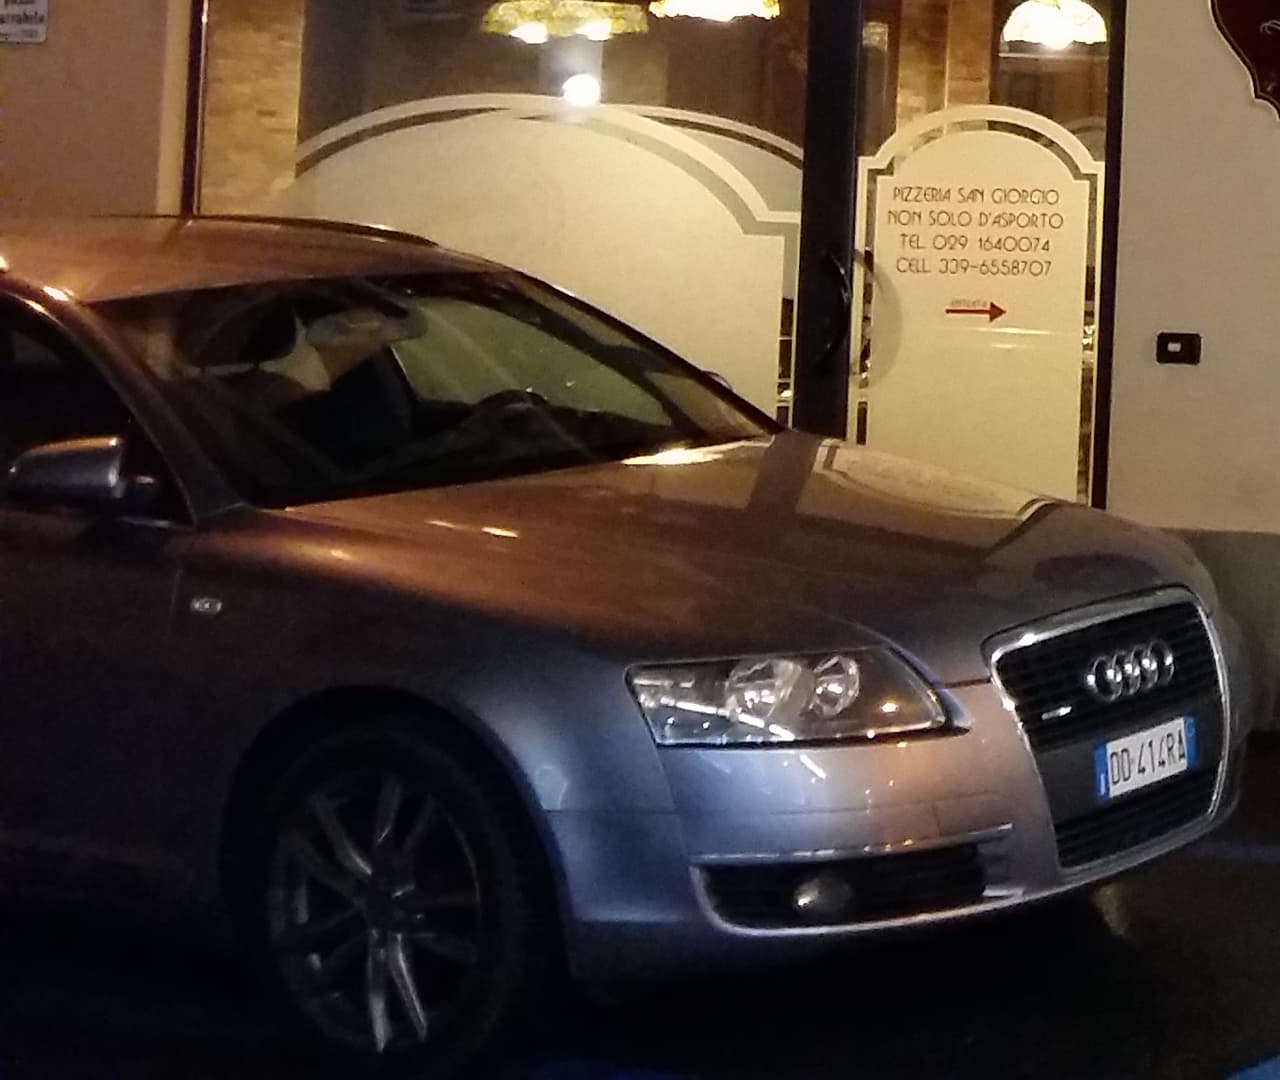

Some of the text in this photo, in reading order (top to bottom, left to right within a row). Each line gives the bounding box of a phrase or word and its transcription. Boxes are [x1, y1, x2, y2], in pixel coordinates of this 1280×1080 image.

[893, 186, 1060, 206] PIZZERIA SAN GIORGIO
[888, 209, 1064, 229] NON SOLO D'ASPORTO
[932, 234, 968, 251] 029
[978, 236, 1050, 252] 1640074
